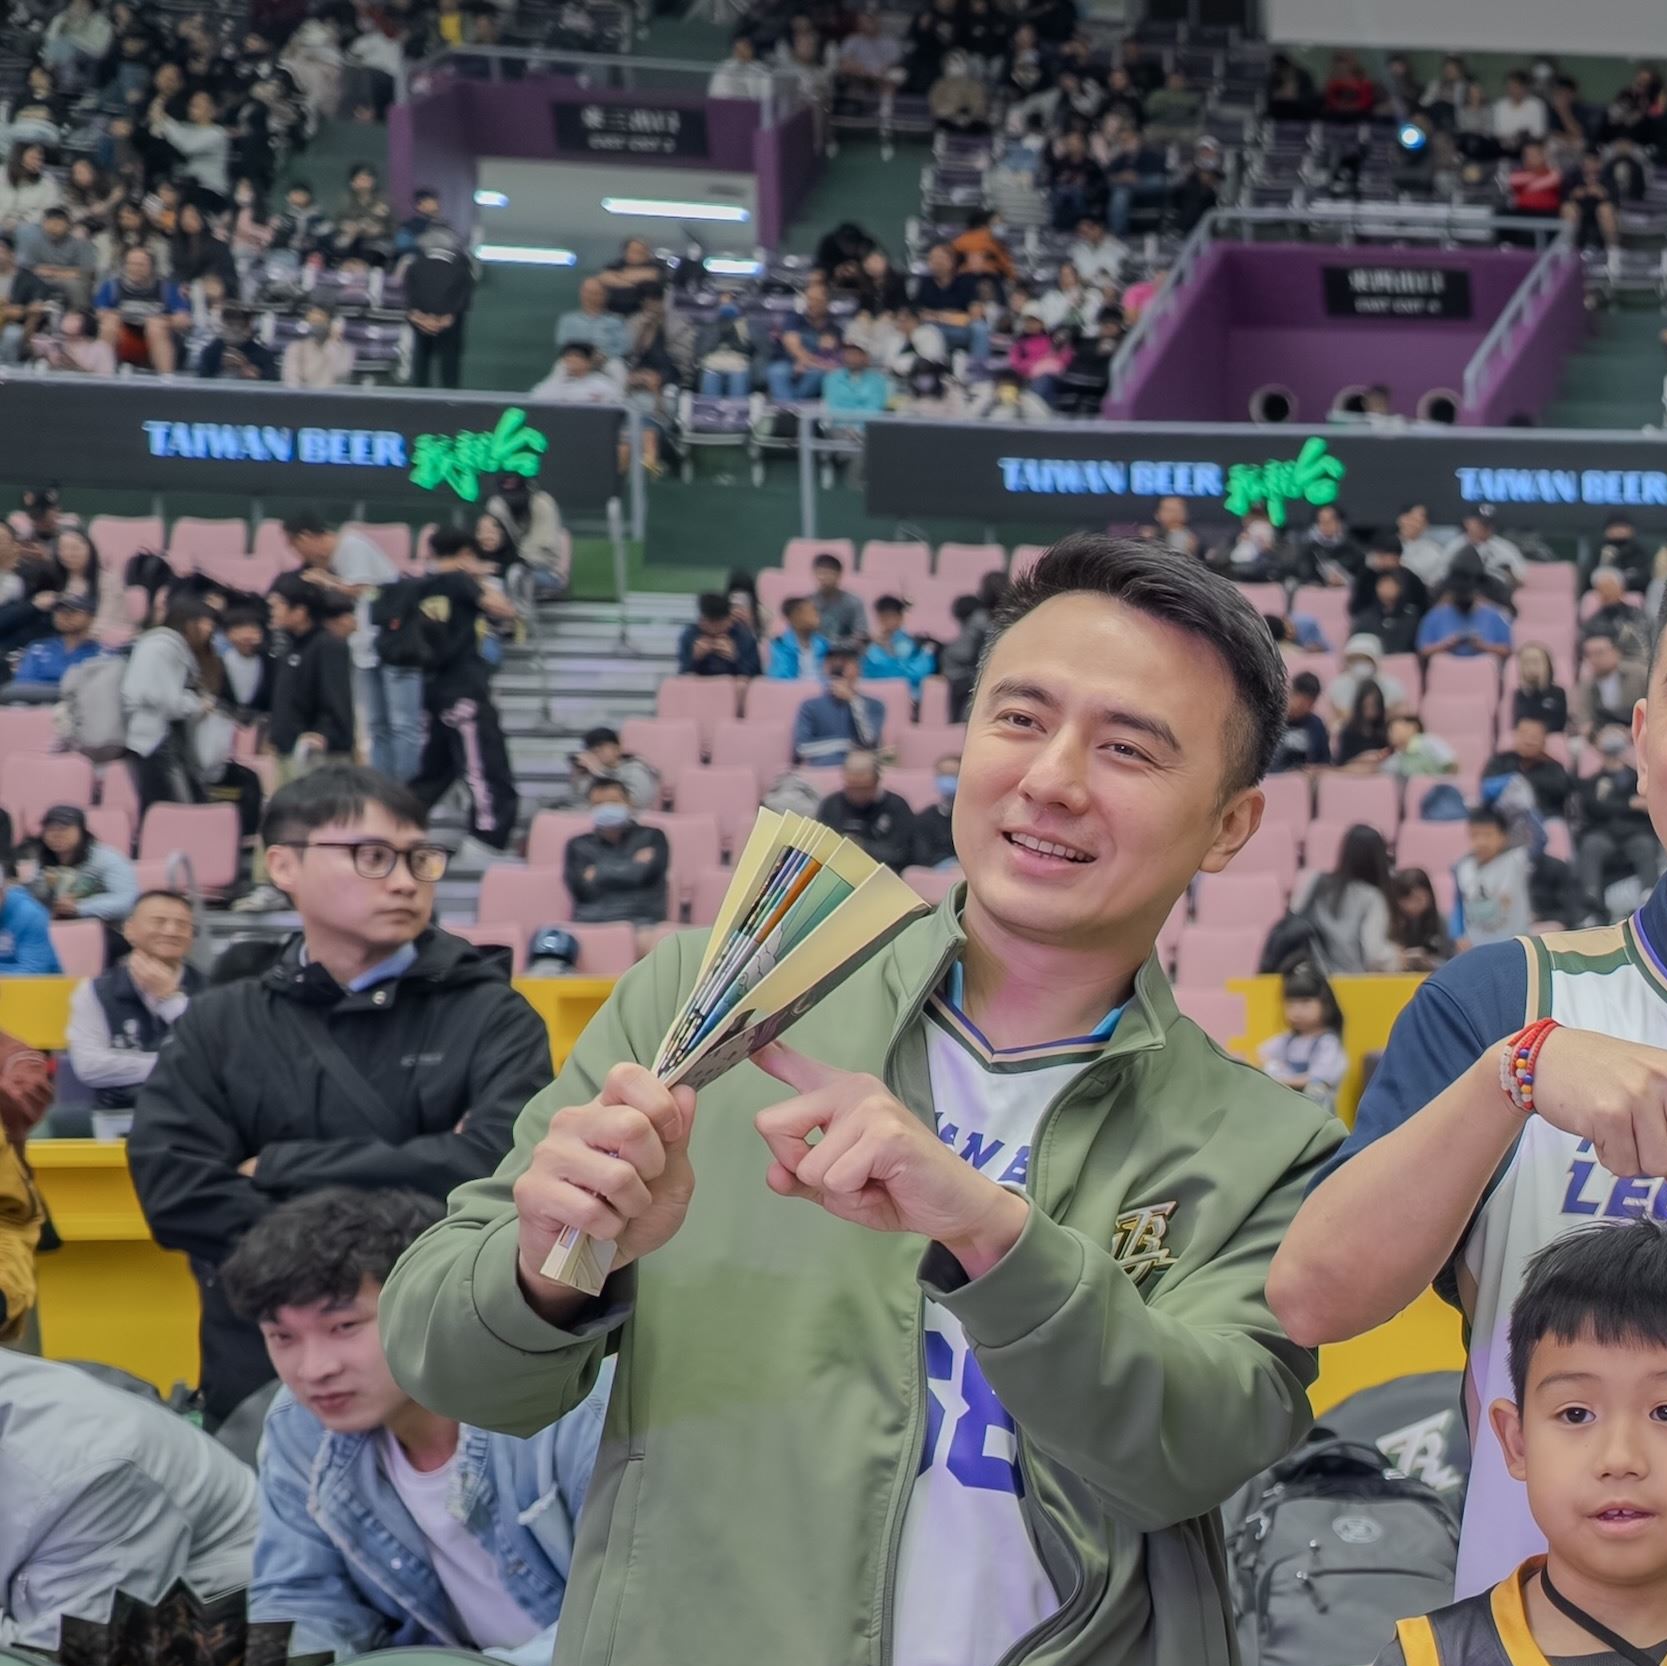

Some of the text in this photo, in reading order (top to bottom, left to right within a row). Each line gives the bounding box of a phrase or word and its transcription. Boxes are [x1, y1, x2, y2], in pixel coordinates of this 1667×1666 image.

[142, 420, 407, 467] TAIWAN BEER
[997, 457, 1223, 497] TAIWAN BEER
[1455, 468, 1577, 504] TAIWAN
